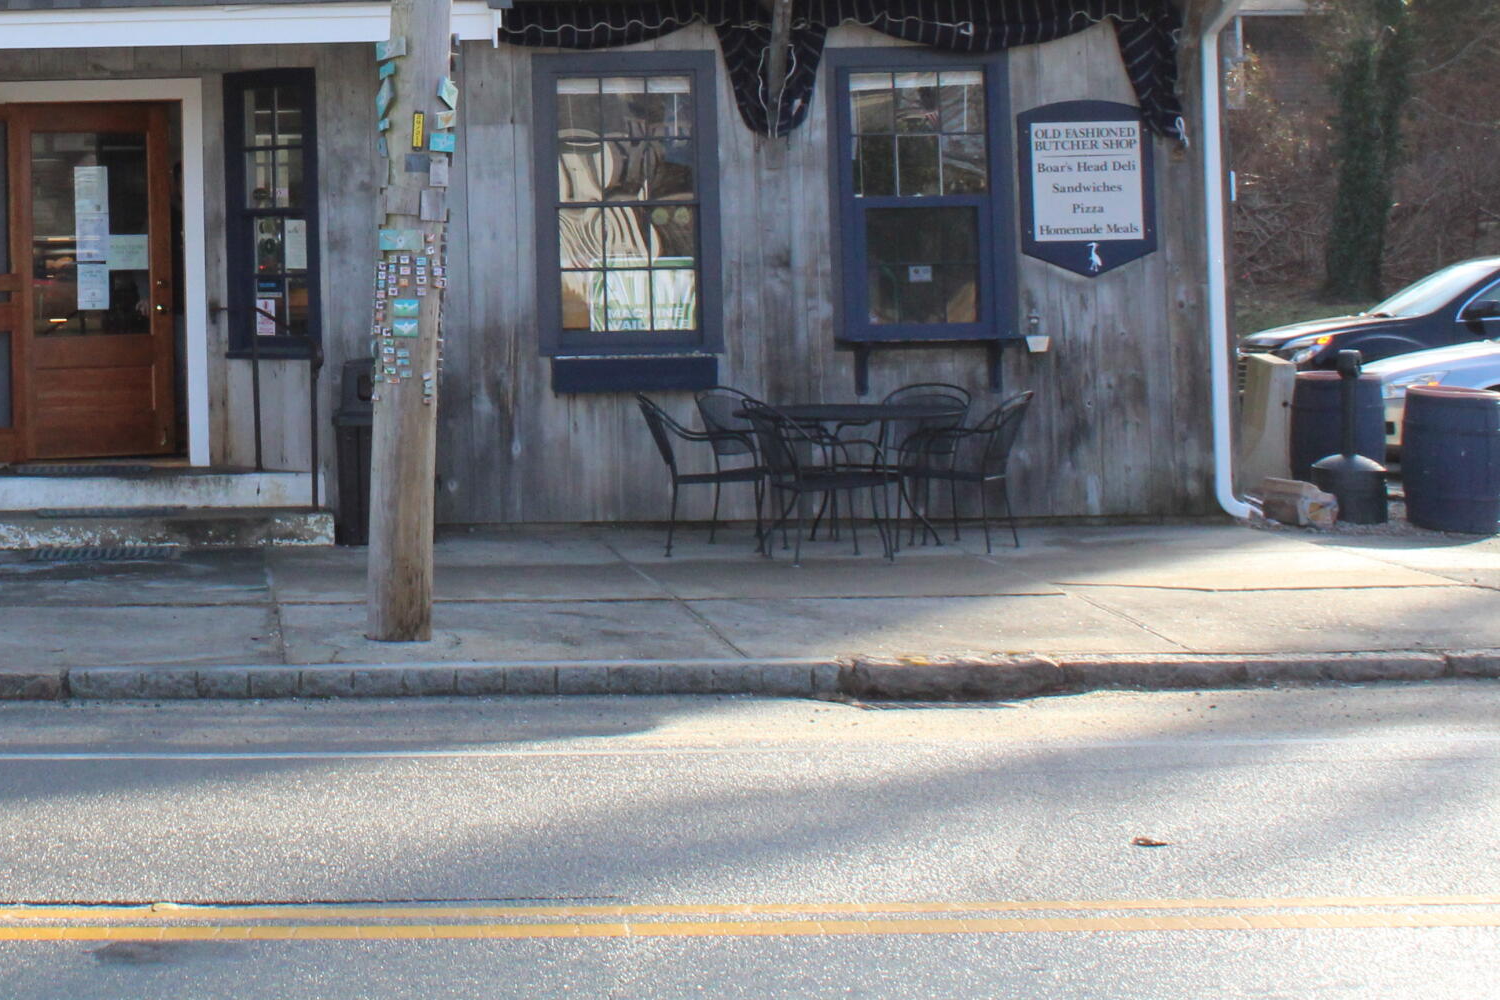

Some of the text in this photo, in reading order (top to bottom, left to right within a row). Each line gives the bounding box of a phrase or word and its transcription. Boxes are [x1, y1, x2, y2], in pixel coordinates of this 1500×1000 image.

[1034, 127, 1136, 139] OLD FASHIONED
[1035, 139, 1137, 151] BUTCHER SHOP
[1037, 160, 1136, 173] Boar's Head Deli
[1052, 182, 1122, 193] Sandwiches
[1072, 203, 1104, 214] Pizza
[1039, 223, 1139, 235] Homemade Meals
[599, 270, 693, 304] ATM
